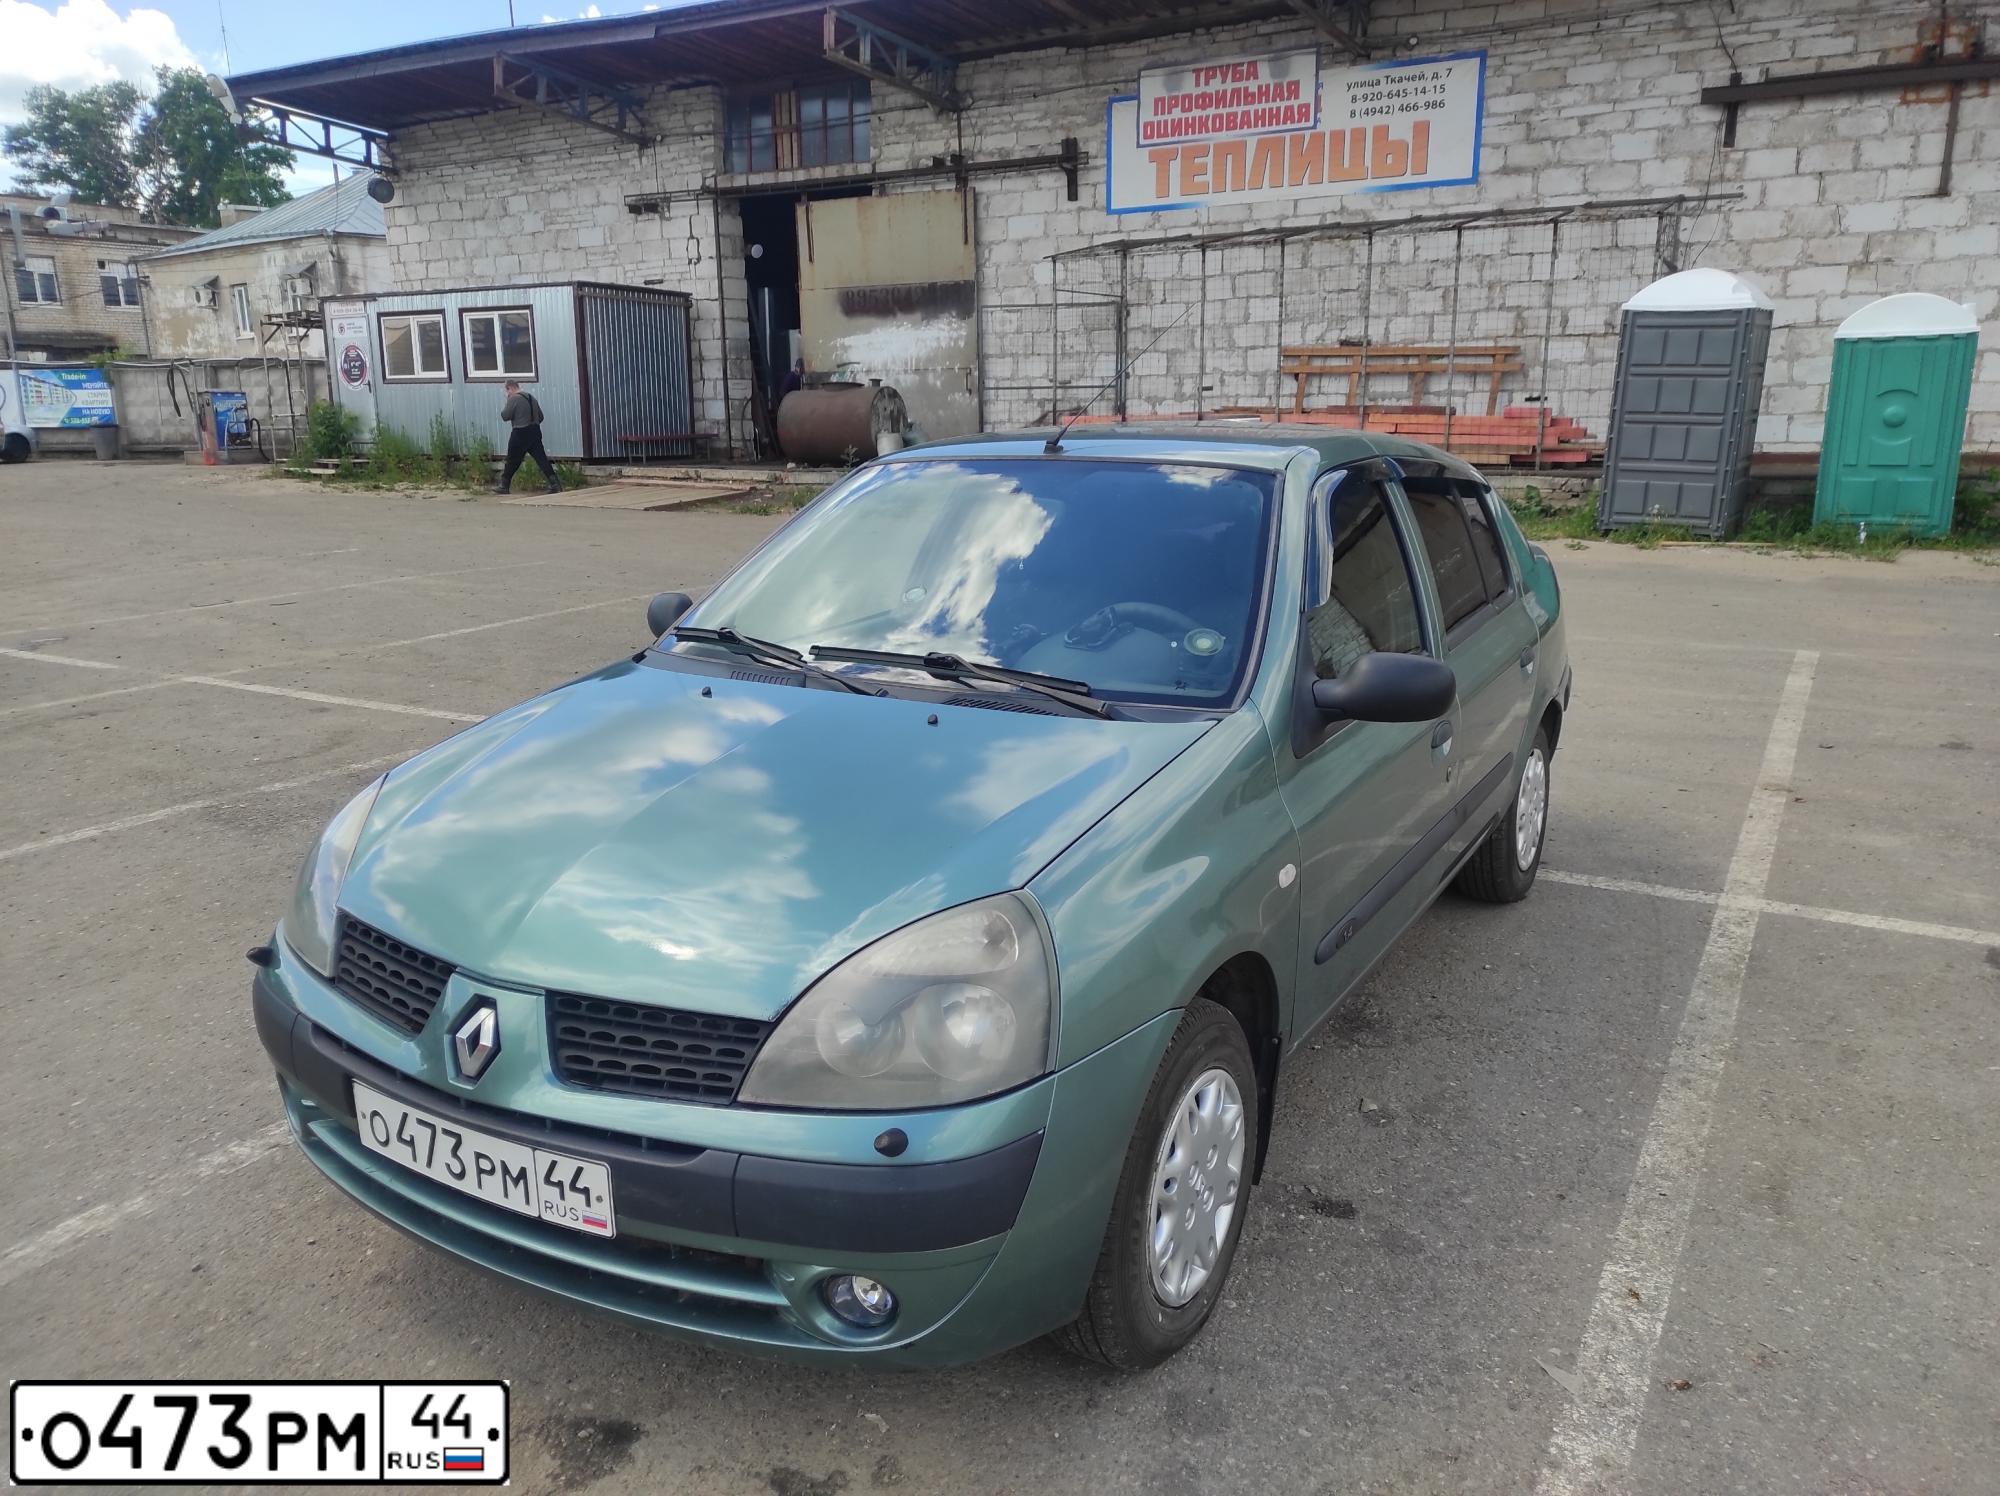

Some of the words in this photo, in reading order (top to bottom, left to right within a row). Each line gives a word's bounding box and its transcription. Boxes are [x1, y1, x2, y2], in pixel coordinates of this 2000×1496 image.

[1192, 60, 1259, 88] ТРУБА
[1346, 78, 1381, 92] улица
[1384, 71, 1428, 85] Ткачей,
[1445, 67, 1453, 78] 7
[1153, 79, 1301, 116] ПРОФИЛЬНАЯ
[1350, 83, 1446, 104] 8-920-645-14-15
[1143, 102, 1311, 140] ОЦИНКОВАННАЯ
[1349, 108, 1357, 119] 8
[1359, 104, 1395, 119] (4942)
[1397, 98, 1446, 114] 466-986
[1149, 119, 1431, 199] ТЕПЛИЦЫ
[543, 1159, 592, 1208] 44
[544, 1200, 579, 1222] RUS
